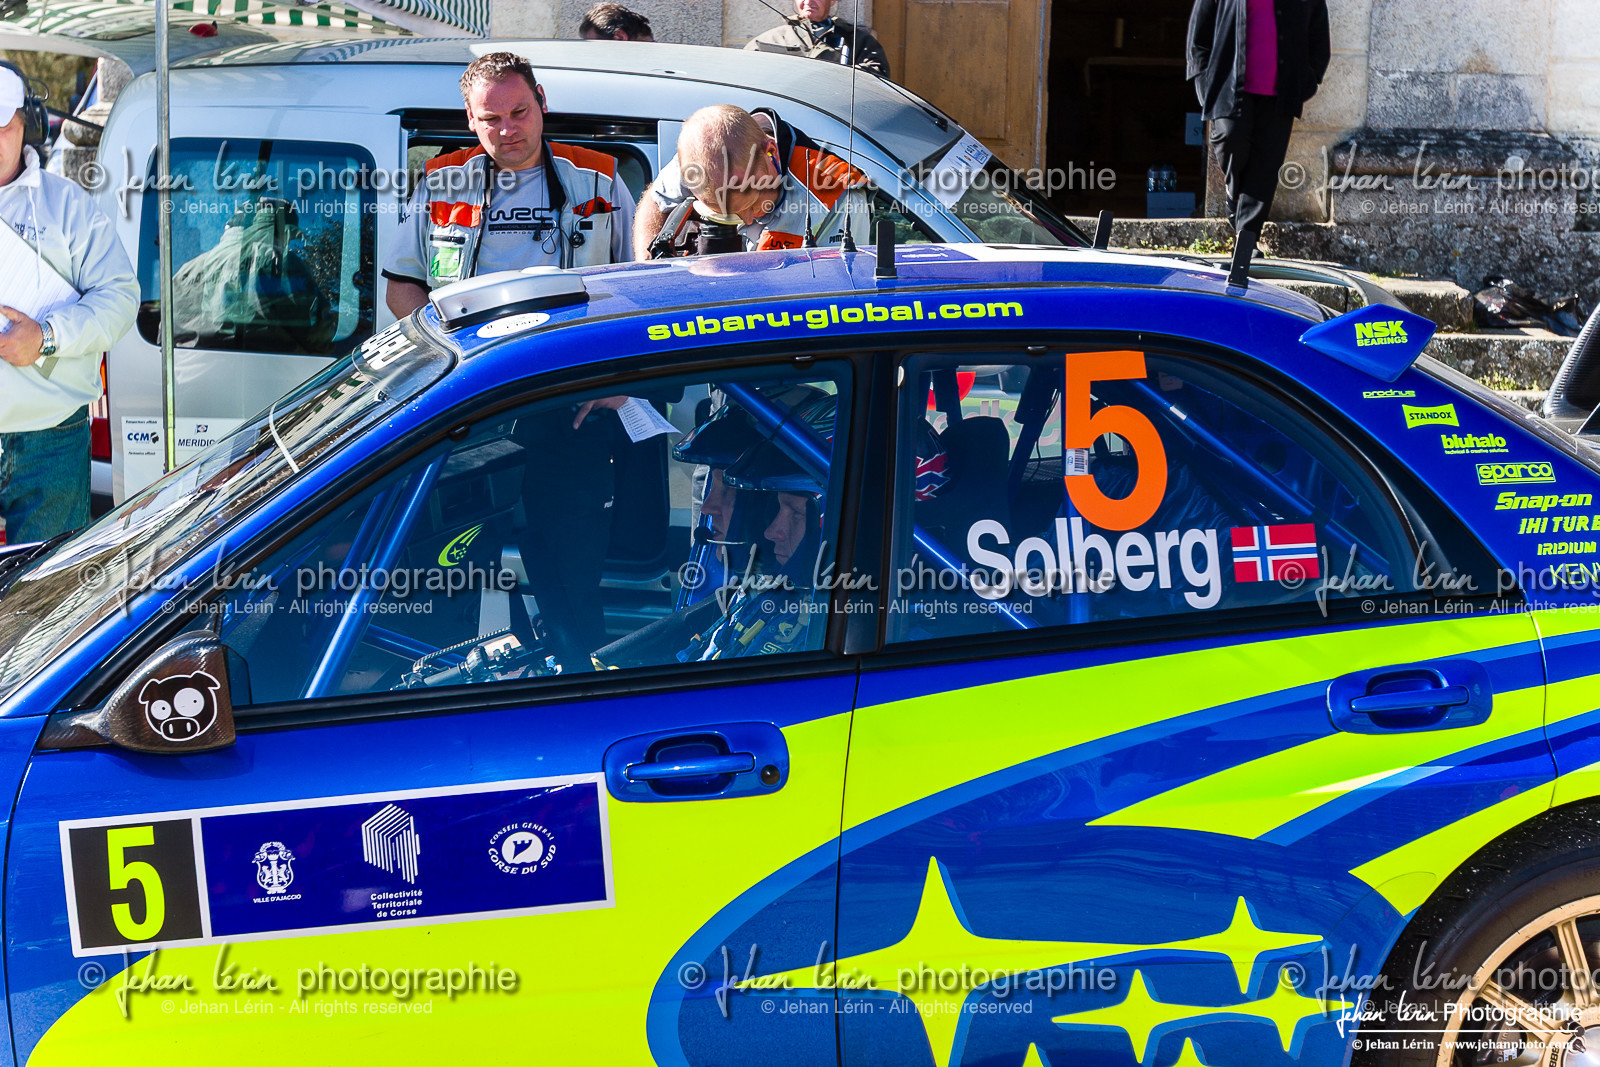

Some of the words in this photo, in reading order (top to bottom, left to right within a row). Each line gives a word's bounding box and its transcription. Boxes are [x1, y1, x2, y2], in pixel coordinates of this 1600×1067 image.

[647, 300, 1024, 342] subaru-global.com
[1354, 320, 1408, 339] NSK
[1357, 336, 1408, 347] BEARINGS
[1409, 411, 1453, 420] STANDOX
[127, 432, 150, 441] CCM
[1064, 350, 1168, 532] 5
[1441, 433, 1507, 449] bluhalo
[1479, 464, 1552, 483] sparco
[1494, 491, 1593, 512] Snap-on
[1518, 517, 1549, 534] IHI
[1537, 541, 1597, 556] IRIDIUM
[967, 516, 1222, 609] Solberg
[489, 823, 519, 845] CONSEIL
[522, 822, 555, 841] GENERAL
[488, 848, 519, 875] CORSE
[521, 864, 538, 875] DU
[540, 844, 557, 869] SUD
[106, 825, 166, 941] 5
[370, 889, 423, 901] Collectivité
[371, 898, 423, 910] Territoriale
[376, 910, 388, 918] de
[390, 908, 417, 917] Corse
